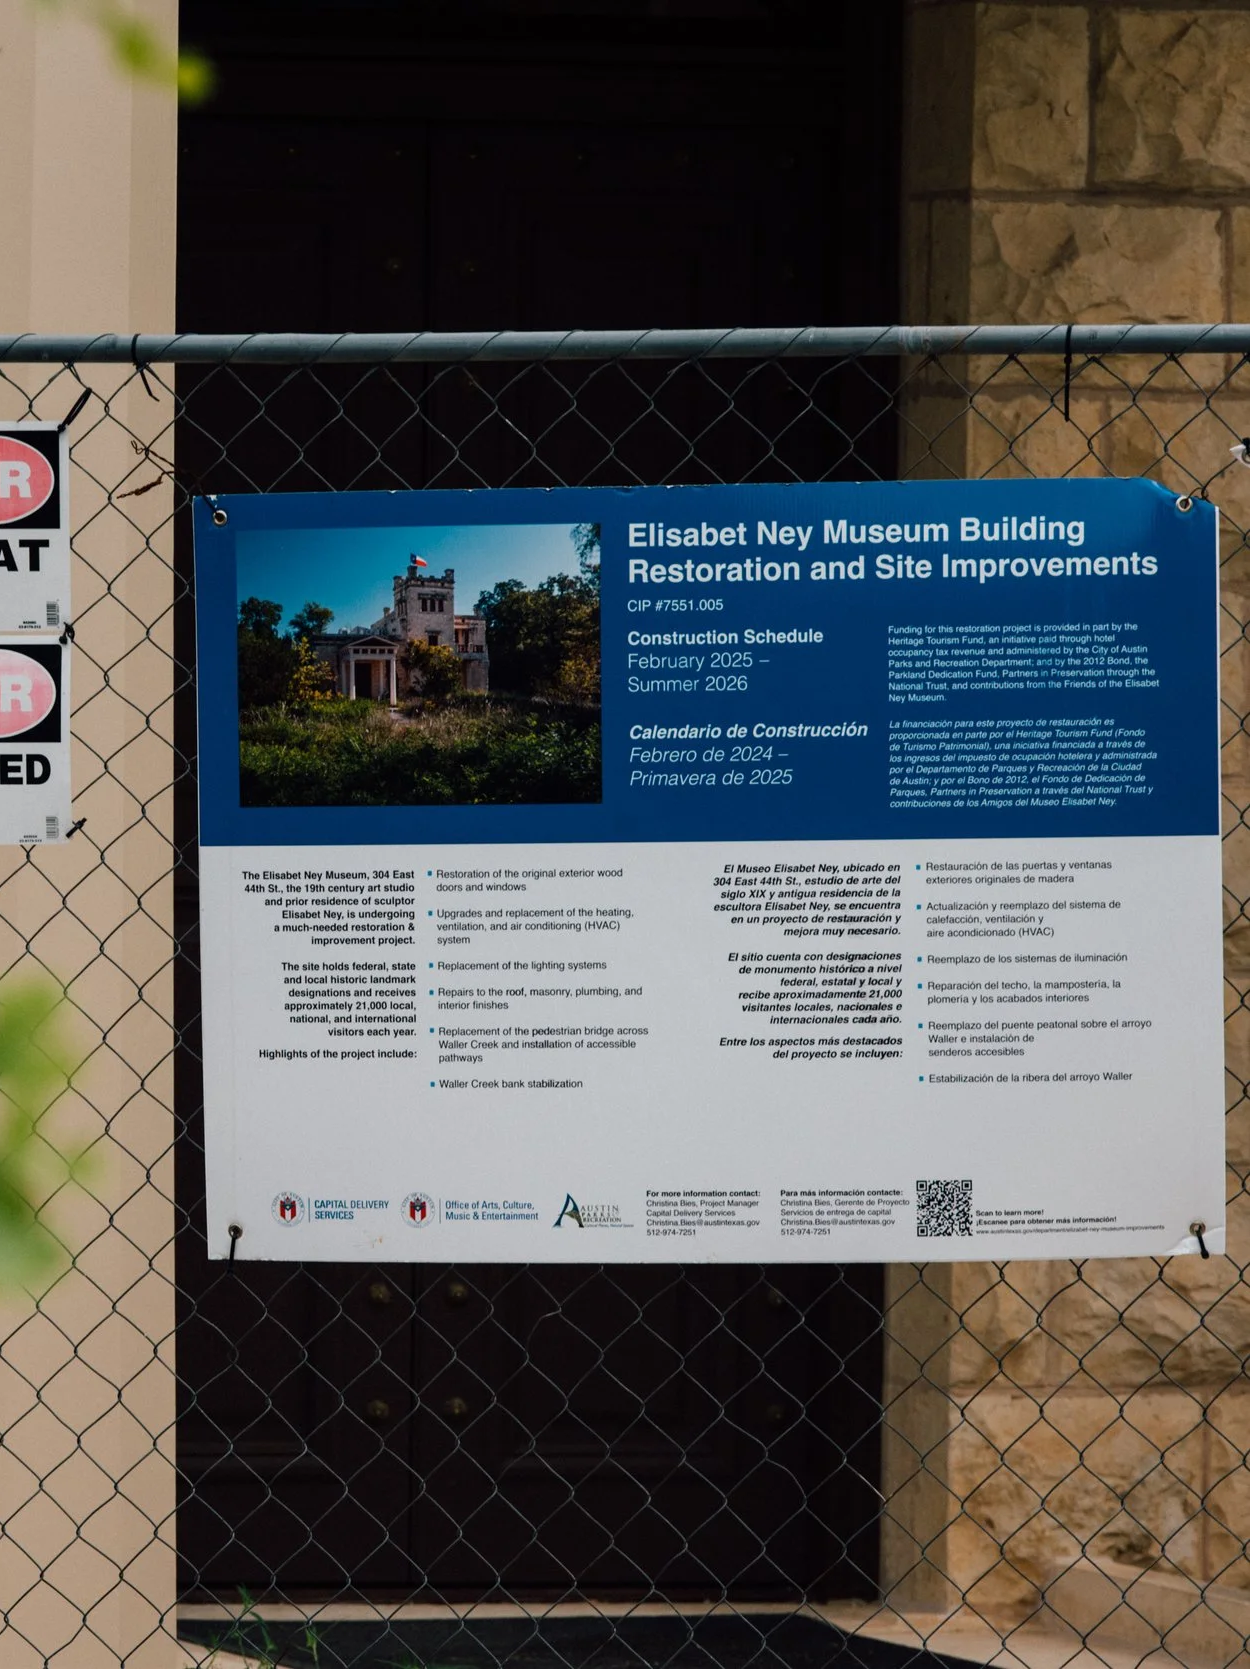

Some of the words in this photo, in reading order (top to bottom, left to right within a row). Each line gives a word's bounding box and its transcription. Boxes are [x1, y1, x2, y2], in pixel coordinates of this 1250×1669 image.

[629, 522, 747, 547] Elisabet
[758, 521, 813, 551] Ney
[824, 520, 949, 544] Museum
[961, 516, 1085, 546] Building
[629, 557, 800, 583] Restoration
[810, 555, 865, 580] and
[876, 554, 932, 579] Site
[943, 552, 1158, 584] Improvements
[628, 600, 651, 612] CIP
[655, 599, 724, 611] #7551.005
[888, 626, 922, 636] Funding
[925, 625, 936, 634] for
[938, 625, 953, 633] this
[956, 625, 1001, 633] restoration
[1003, 625, 1031, 634] project
[1043, 623, 1080, 633] provided
[1093, 624, 1109, 633] part
[1112, 623, 1122, 632] by
[628, 630, 738, 646] Construction
[744, 628, 823, 644] Schedule
[888, 637, 924, 647] Heritage
[926, 636, 960, 645] Tourism
[962, 636, 986, 644] Fund,
[1039, 635, 1057, 644] paid
[1059, 635, 1092, 644] through
[1094, 634, 1115, 642] hotel
[628, 653, 705, 672] February
[711, 652, 753, 668] 2025
[628, 676, 700, 693] Summer
[705, 675, 748, 691] 2026
[889, 721, 900, 729] La
[903, 720, 953, 728] financiación
[954, 721, 974, 729] para
[996, 719, 1034, 728] proyecto
[1036, 719, 1047, 727] de
[1049, 717, 1102, 726] restauración
[630, 724, 722, 740] Calendario
[727, 724, 748, 738] de
[753, 722, 868, 738] Construcción
[630, 747, 697, 763] Febrero
[703, 746, 725, 762] de
[730, 746, 773, 762] 2024
[630, 771, 716, 786] Primavera
[722, 770, 744, 785] de
[749, 769, 793, 785] 2025
[724, 865, 734, 873] El
[737, 865, 771, 873] Museo
[774, 864, 816, 873] Elisabet
[818, 864, 840, 874] Ney,
[843, 863, 885, 872] ubicado
[926, 862, 988, 871] Restauración
[991, 862, 1003, 870] de
[1006, 862, 1019, 870] las
[1022, 862, 1058, 872] puertas
[1060, 863, 1066, 872] y
[1069, 861, 1112, 869] ventanas
[242, 871, 260, 880] The
[263, 871, 301, 880] Elisabet
[304, 871, 323, 882] Ney
[326, 871, 370, 880] Museum,
[373, 870, 390, 879] 304
[393, 870, 414, 879] East
[437, 870, 490, 879] Restoration
[493, 869, 502, 878] of
[505, 869, 519, 878] the
[522, 869, 556, 880] original
[559, 869, 595, 878] exterior
[597, 869, 623, 877] wood
[926, 876, 973, 884] exteriores
[975, 875, 1021, 886] originales
[1023, 875, 1036, 883] de
[1038, 874, 1074, 883] madera
[245, 884, 265, 893] 44th
[268, 884, 283, 894] St.,
[286, 884, 302, 893] the
[305, 884, 325, 893] 19th
[328, 884, 365, 894] century
[368, 884, 381, 892] art
[384, 883, 415, 892] studio
[436, 883, 463, 892] doors
[465, 883, 483, 892] and
[486, 882, 527, 891] windows
[265, 897, 283, 906] and
[286, 897, 308, 908] prior
[311, 897, 359, 906] residence
[362, 897, 371, 905] of
[374, 897, 415, 907] sculptor
[282, 910, 320, 919] Elisabet
[324, 910, 344, 921] Ney,
[347, 910, 356, 919] is
[359, 910, 415, 920] undergoing
[283, 923, 348, 932] much-needed
[351, 923, 405, 932] restoration
[408, 923, 415, 931] &
[312, 936, 375, 947] improvement
[378, 936, 415, 946] project.
[259, 1049, 308, 1060] Highlights
[311, 1049, 320, 1058] of
[323, 1049, 338, 1058] the
[341, 1049, 375, 1060] project
[378, 1049, 417, 1058] include:
[439, 1080, 468, 1088] Waller
[471, 1079, 499, 1088] Creek
[502, 1080, 525, 1088] bank
[528, 1080, 583, 1088] stabilization
[315, 1200, 348, 1209] CAPITAL
[351, 1200, 389, 1209] DELIVERY
[445, 1201, 469, 1210] Office
[472, 1201, 479, 1209] of
[482, 1201, 500, 1210] Arts,
[503, 1201, 534, 1210] Culture,
[315, 1211, 354, 1220] SERVICES
[446, 1211, 470, 1220] Music
[473, 1211, 479, 1220] &
[481, 1211, 538, 1220] Entertainment
[647, 1219, 760, 1229] Christina.Bies@austintexas.gov
[781, 1228, 830, 1236] 512-974-7251
